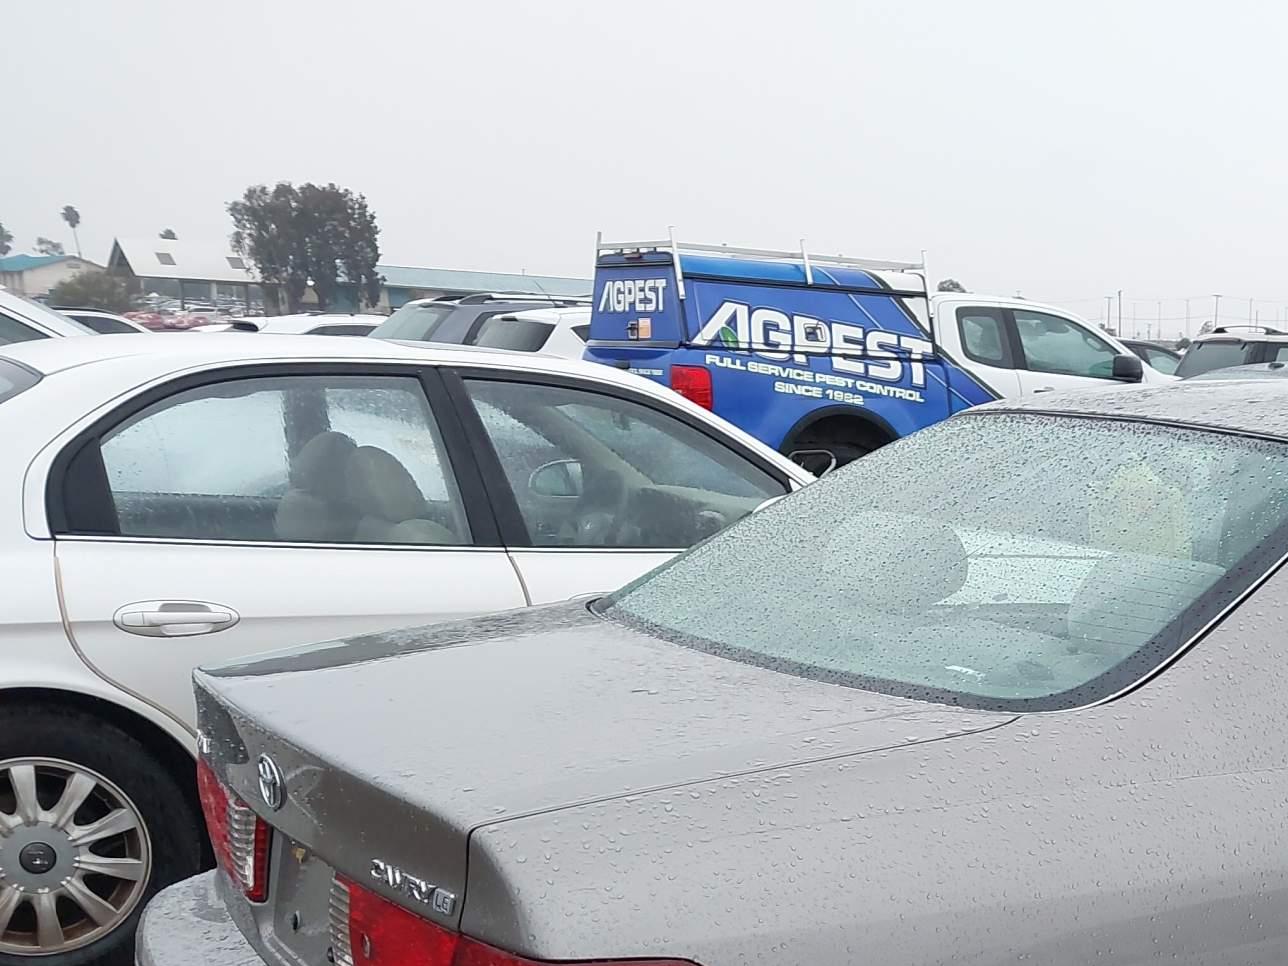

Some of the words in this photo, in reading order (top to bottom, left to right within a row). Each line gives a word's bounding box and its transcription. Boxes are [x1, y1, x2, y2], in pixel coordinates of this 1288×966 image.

[599, 279, 667, 312] AGPEST
[690, 301, 934, 387] AGPEST
[705, 354, 746, 371] FULL
[748, 361, 814, 382] SERVICE
[815, 373, 855, 388] PEST
[856, 380, 924, 403] CONTROL
[774, 381, 822, 398] SINCE
